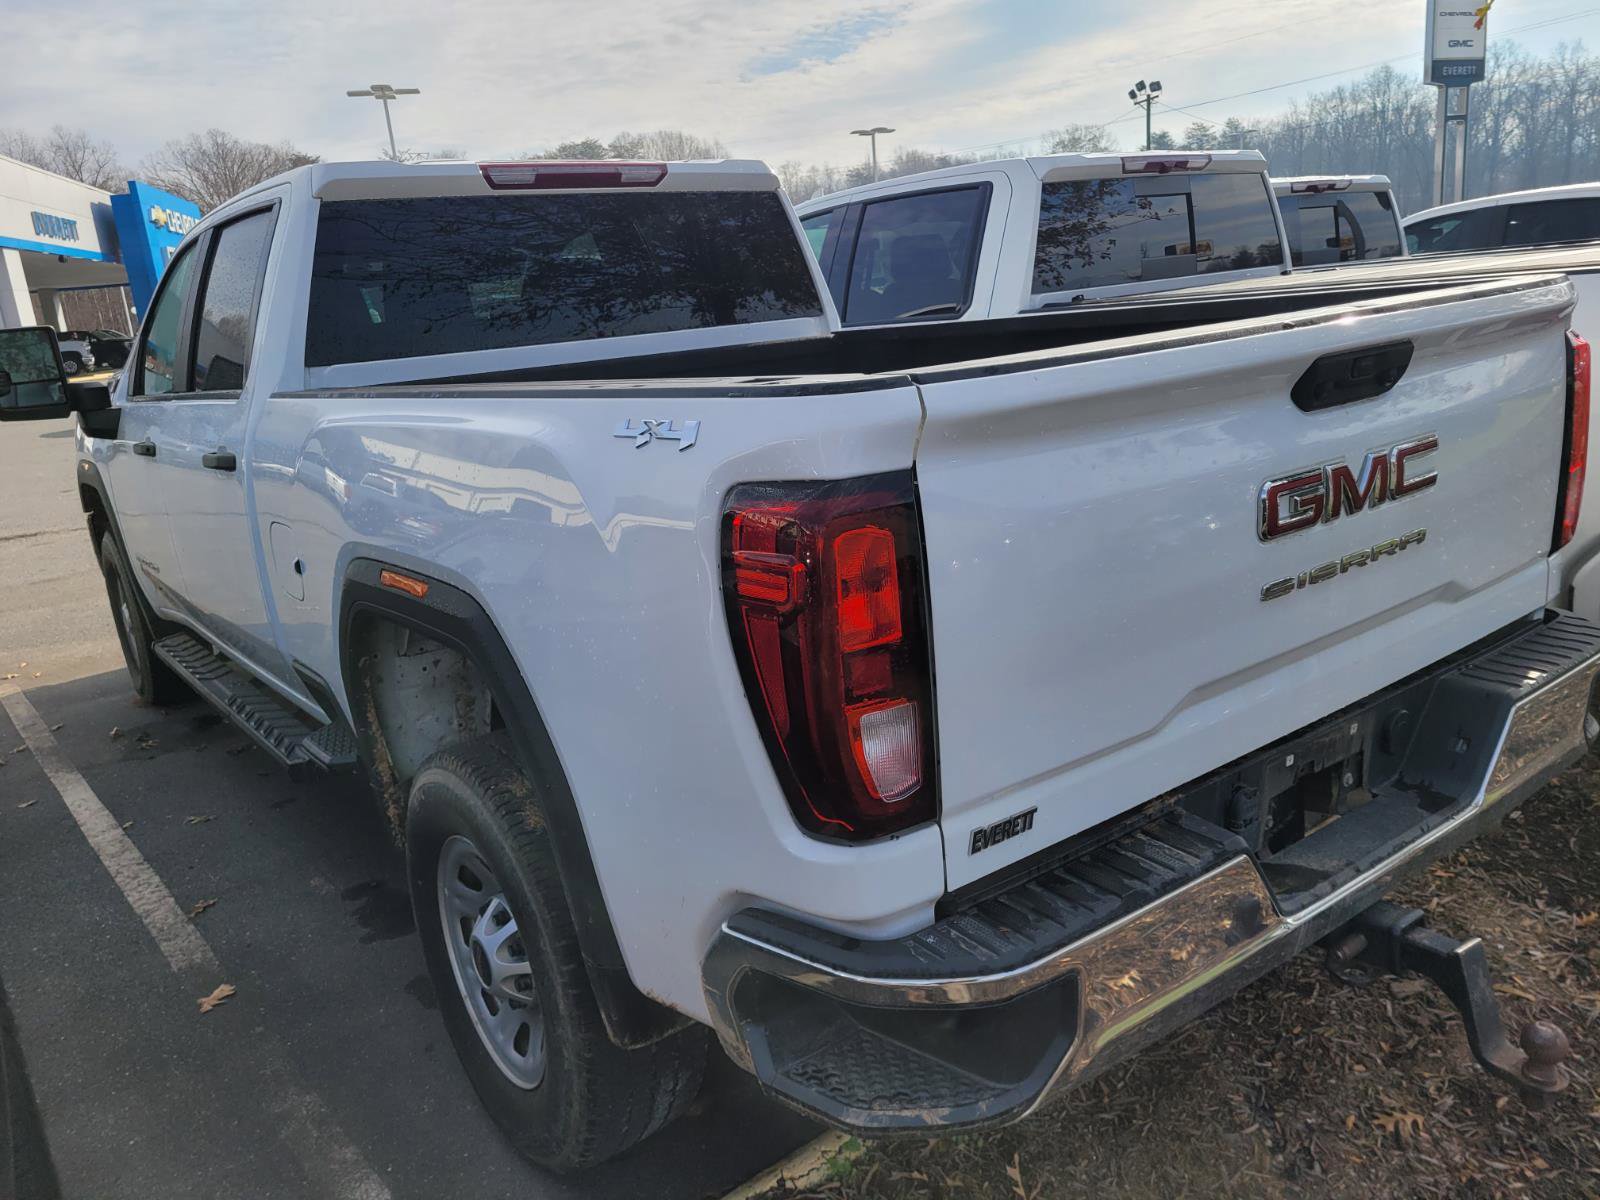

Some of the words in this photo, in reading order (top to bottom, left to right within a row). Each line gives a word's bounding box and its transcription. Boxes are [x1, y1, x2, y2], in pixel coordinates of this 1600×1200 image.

[1448, 39, 1474, 48] GMC
[1442, 65, 1477, 76] EVERETT
[1257, 433, 1438, 542] GMC
[1260, 528, 1427, 601] SIERRA
[968, 805, 1038, 856] EVERETT
